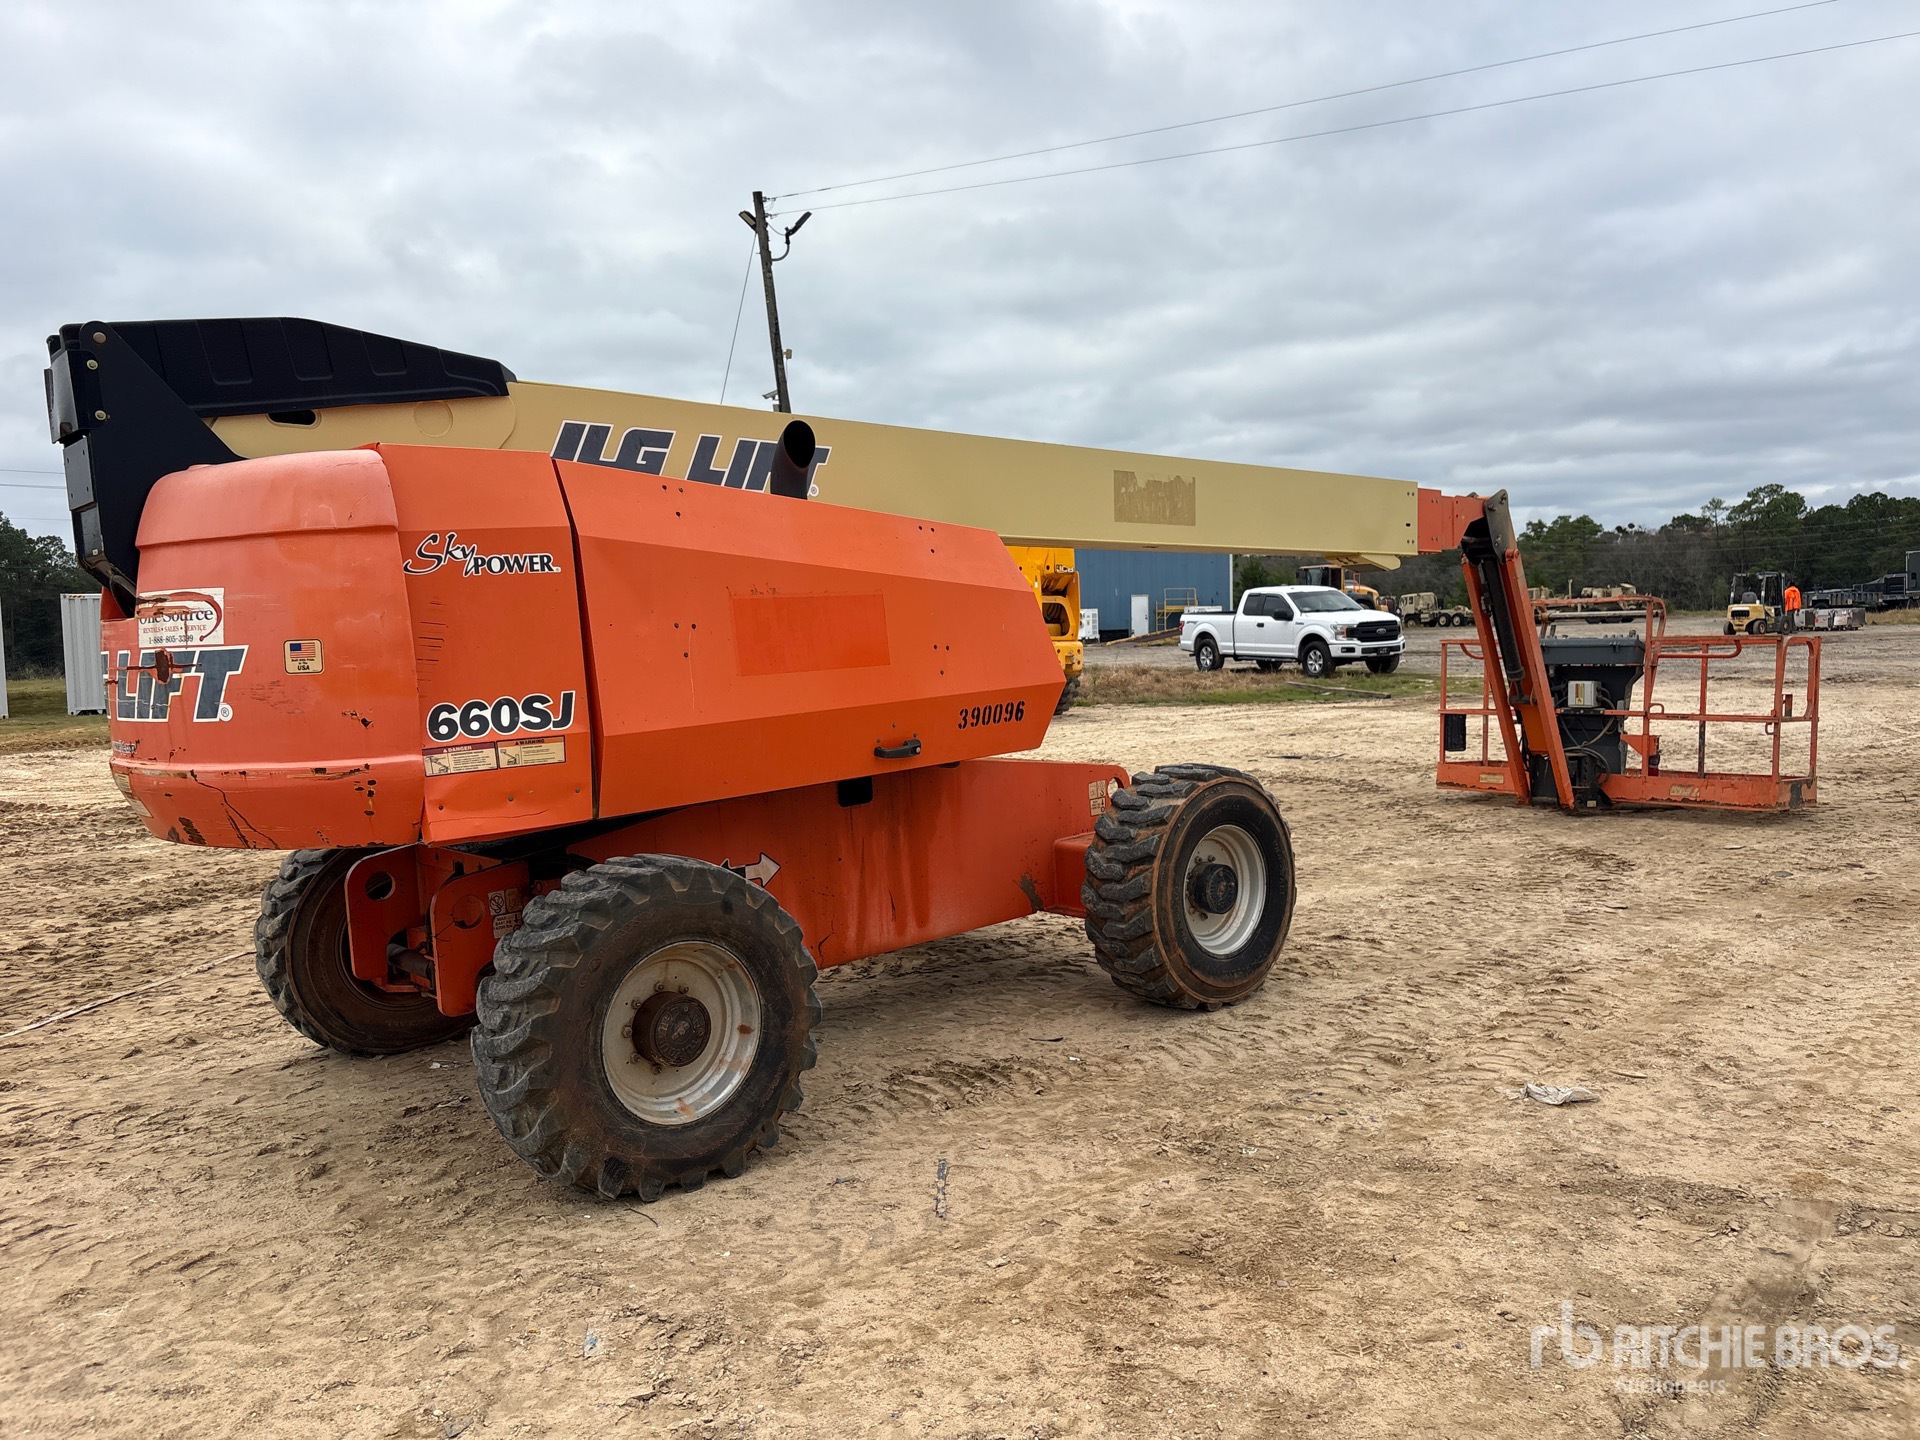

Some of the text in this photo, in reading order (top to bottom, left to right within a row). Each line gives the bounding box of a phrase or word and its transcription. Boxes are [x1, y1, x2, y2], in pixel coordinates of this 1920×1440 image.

[403, 532, 477, 577] Sky
[473, 554, 554, 575] POWER
[116, 645, 249, 722] LIFT
[426, 690, 576, 742] 660SJ
[958, 700, 1026, 729] 390096
